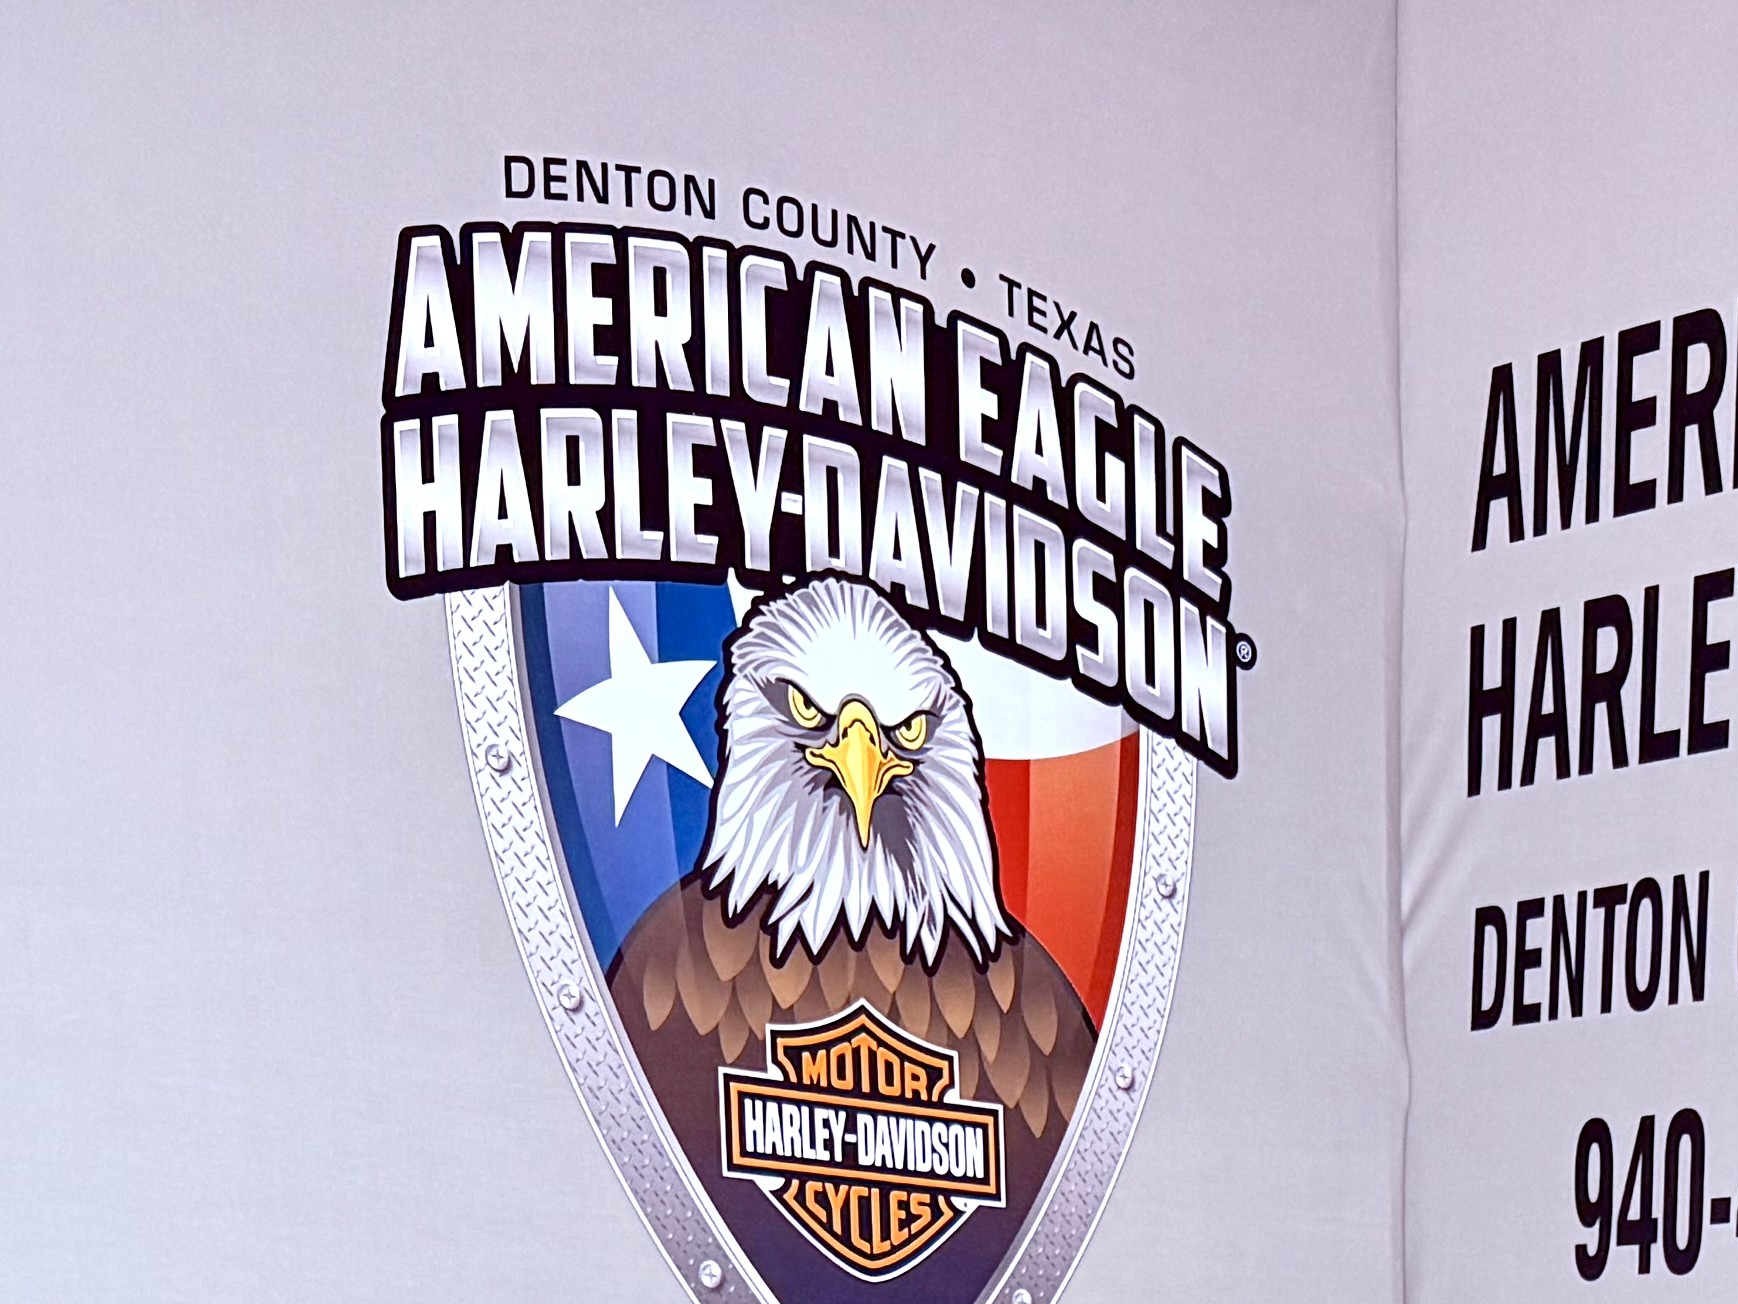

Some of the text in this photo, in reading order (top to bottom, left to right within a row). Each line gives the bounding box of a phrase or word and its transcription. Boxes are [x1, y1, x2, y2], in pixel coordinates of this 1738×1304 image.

[503, 154, 1137, 381] DENTON COUNTY TEXAS
[394, 230, 1226, 603] AMERICAN EAGLE
[1470, 869, 1711, 1033] DENTON
[801, 1032, 928, 1102] MOTOR
[743, 1098, 985, 1179] HARLEY-DAVIDSON
[805, 1180, 932, 1255] CYCLES
